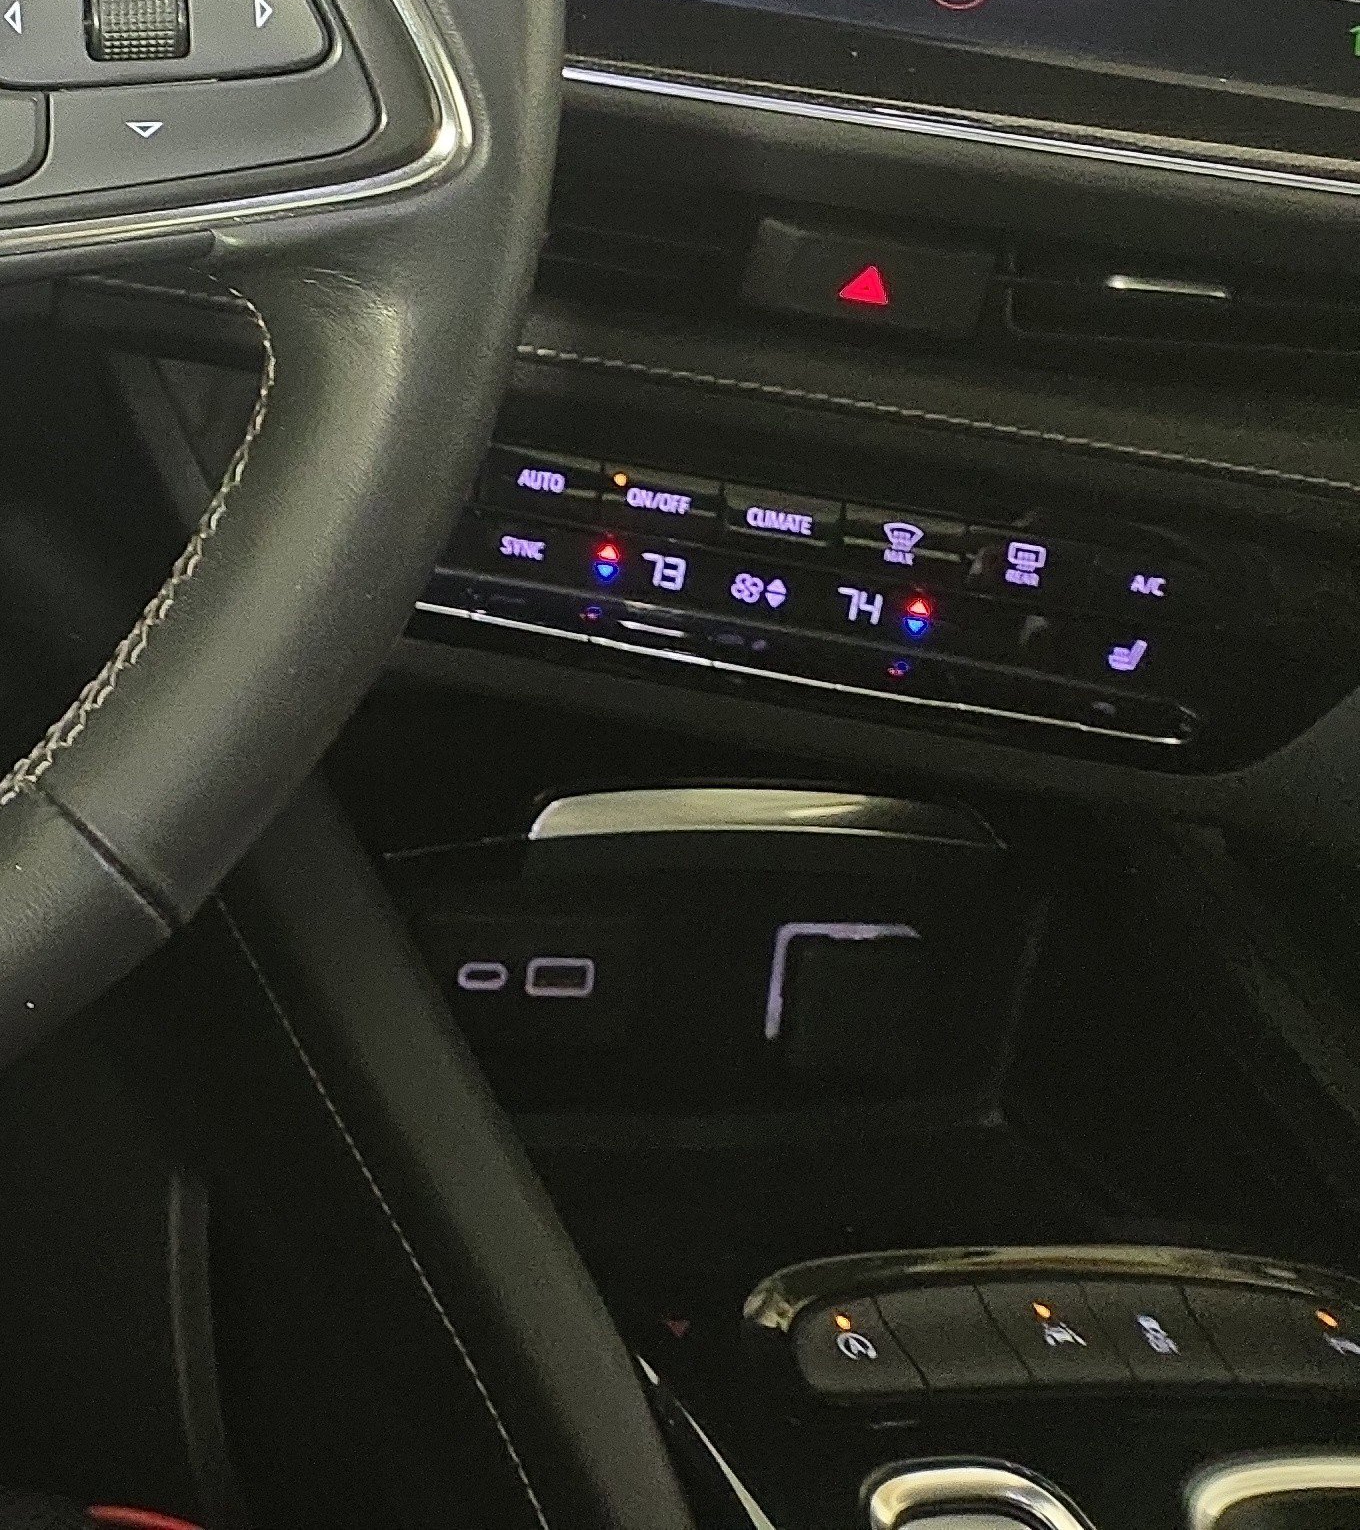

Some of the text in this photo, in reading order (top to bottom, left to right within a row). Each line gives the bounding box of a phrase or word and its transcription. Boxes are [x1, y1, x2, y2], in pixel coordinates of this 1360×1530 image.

[516, 468, 566, 494] AUTO
[625, 486, 692, 516] ON/OFF
[746, 506, 813, 536] CLIMATE
[499, 535, 546, 561] SYNC
[641, 552, 687, 592] 73
[1130, 575, 1166, 597] A/C
[837, 586, 884, 626] 74
